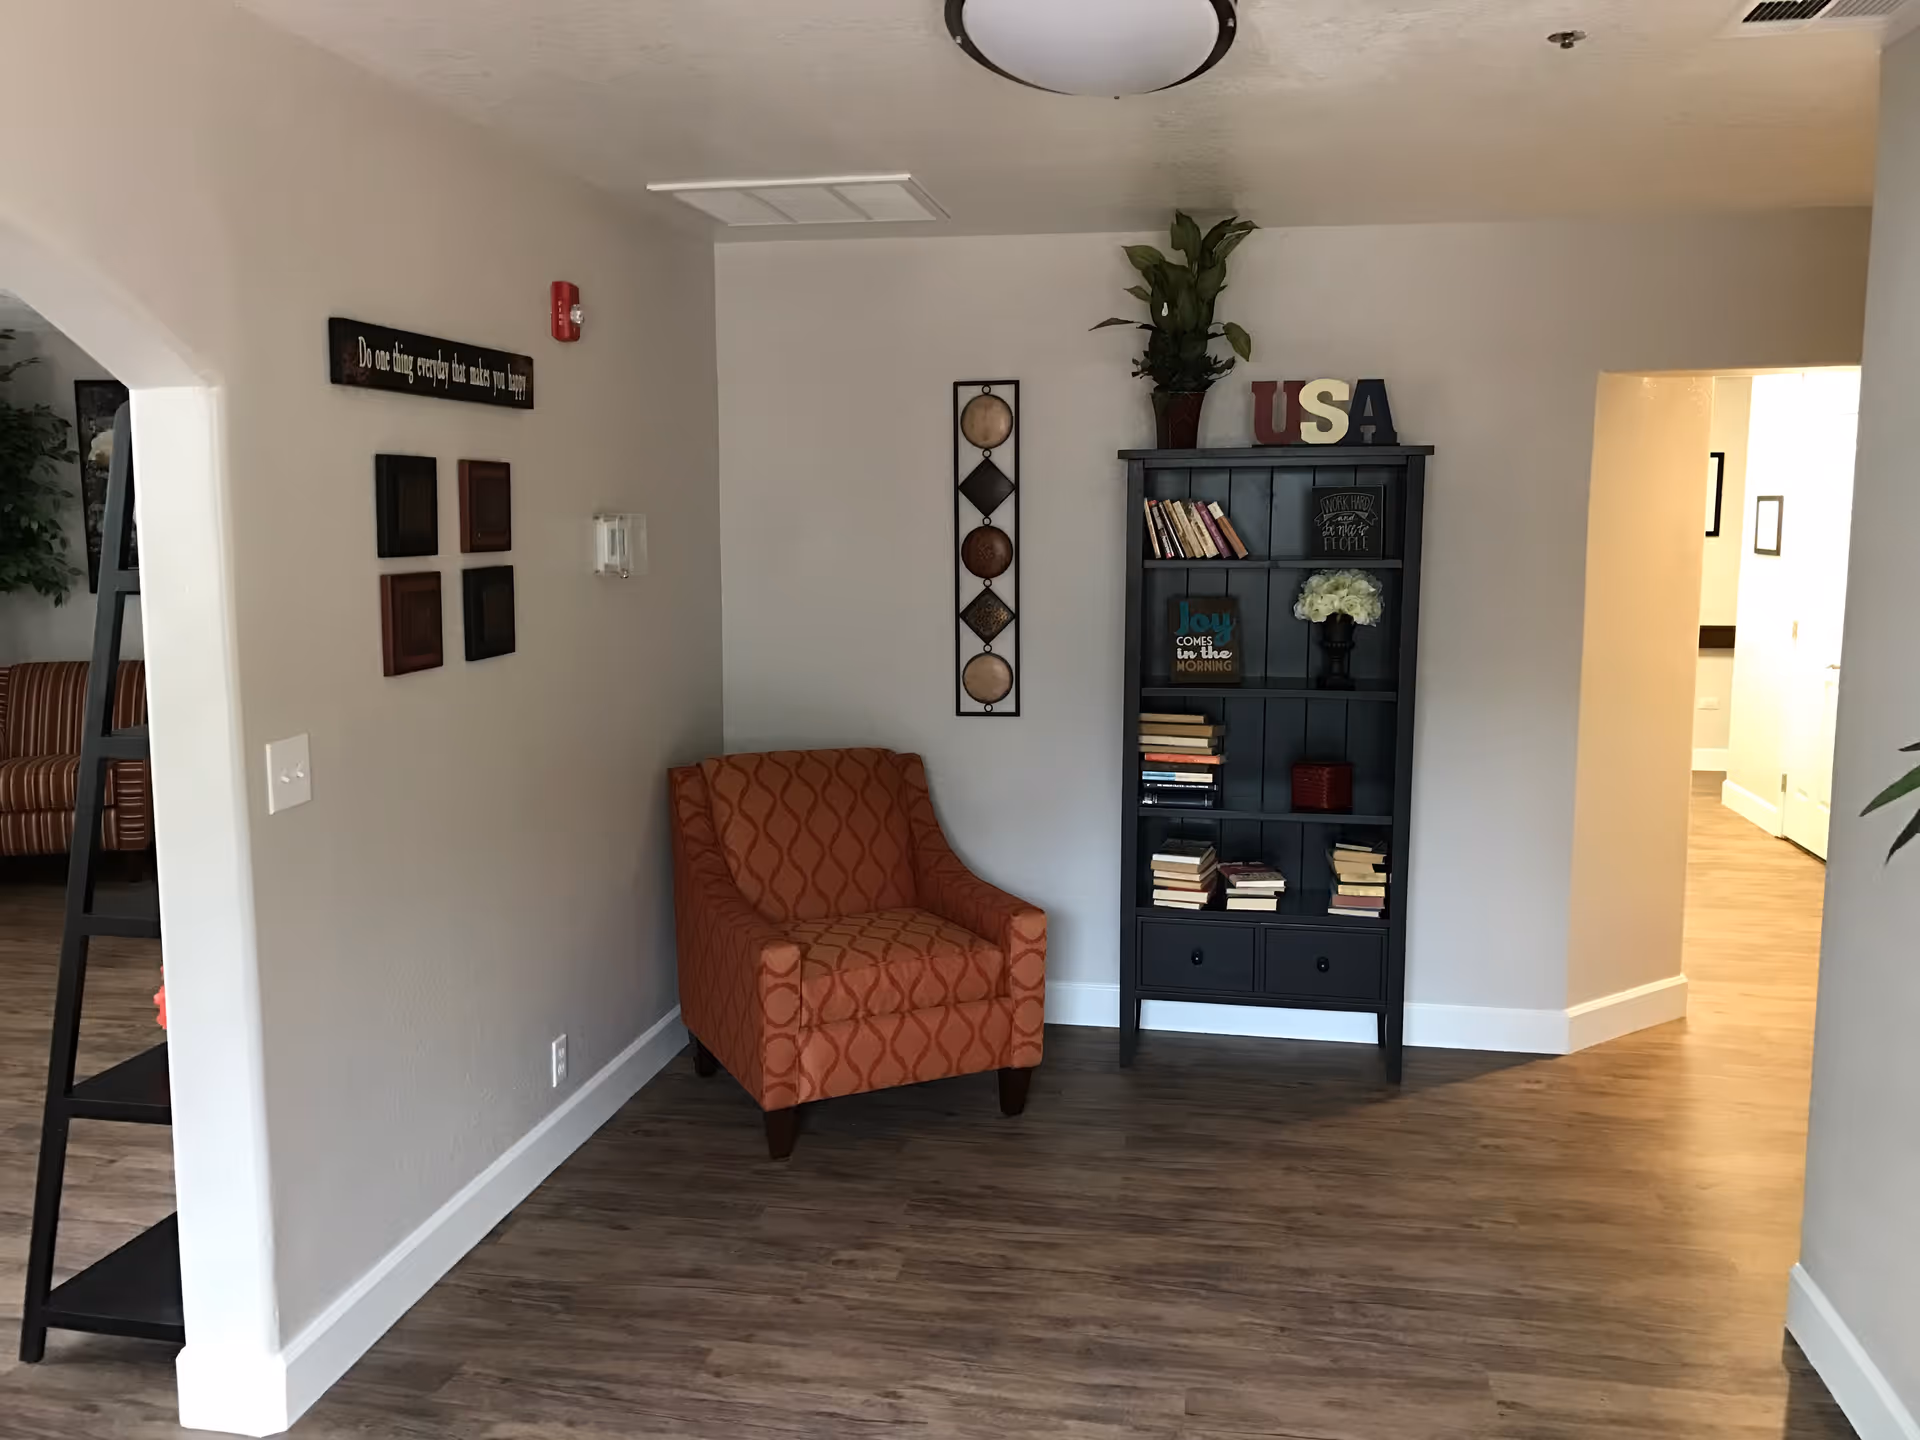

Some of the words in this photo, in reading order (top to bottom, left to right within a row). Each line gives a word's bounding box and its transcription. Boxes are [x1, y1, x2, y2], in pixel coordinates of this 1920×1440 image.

[358, 336, 372, 368] Do
[375, 349, 390, 371] one
[393, 341, 414, 384] thing
[417, 348, 449, 389] everyday
[452, 352, 466, 383] that
[470, 357, 489, 387] makes
[493, 370, 505, 396] you
[508, 363, 526, 400] happy
[1251, 378, 1397, 445] USA
[1322, 495, 1349, 513] WORK
[1351, 495, 1370, 511] HARD
[1322, 521, 1335, 536] be
[1337, 524, 1357, 537] nice
[1174, 601, 1235, 647] Joy
[1176, 636, 1212, 646] COMES
[1176, 648, 1197, 659] in
[1200, 646, 1232, 659] the
[1176, 660, 1232, 671] MORNING
